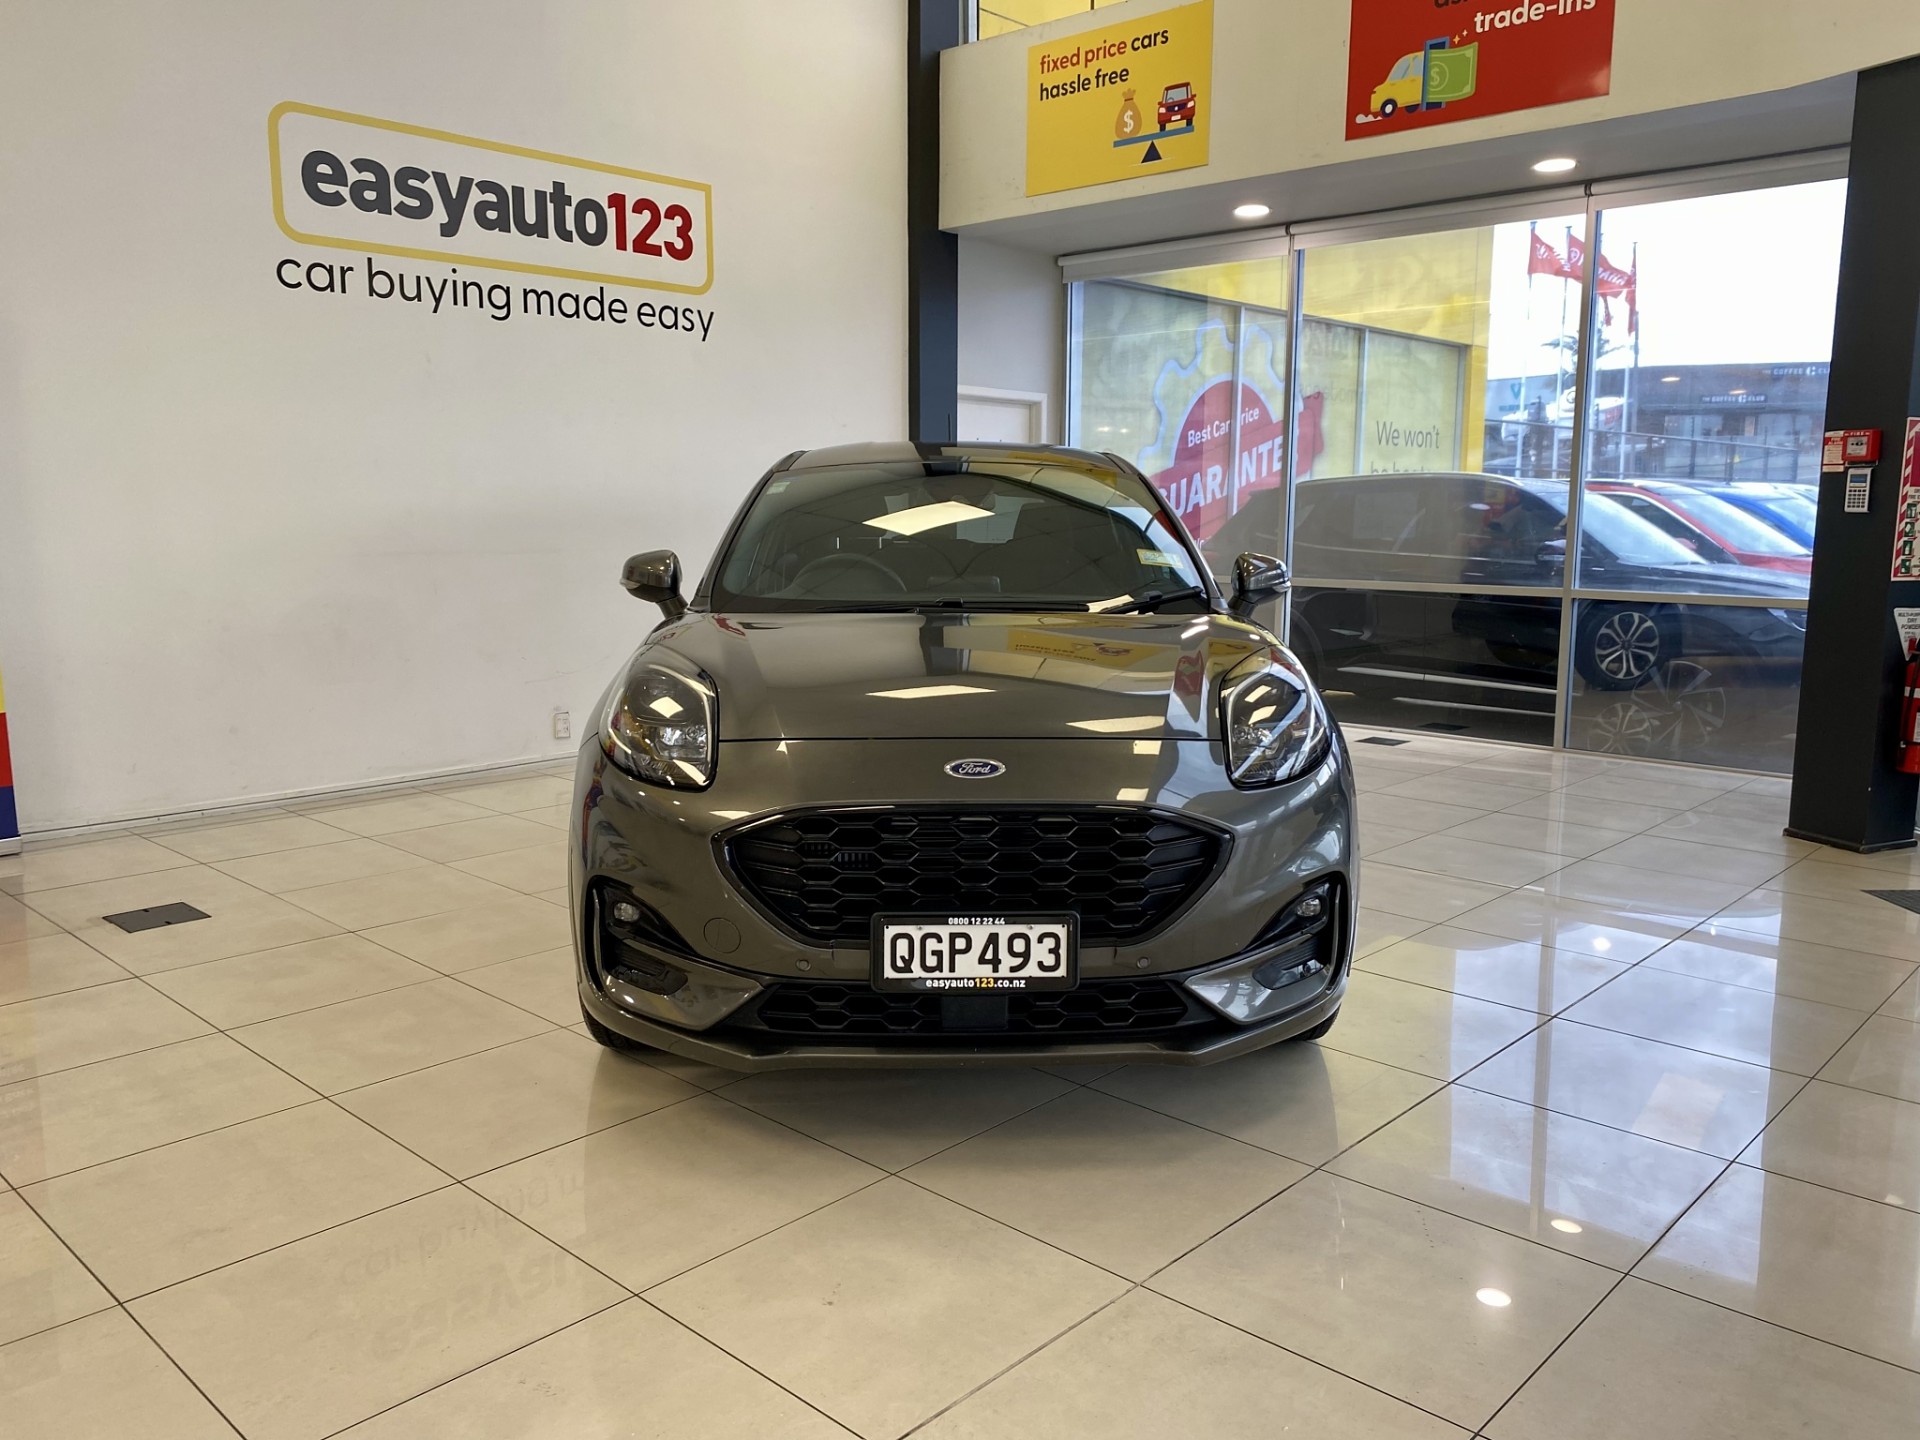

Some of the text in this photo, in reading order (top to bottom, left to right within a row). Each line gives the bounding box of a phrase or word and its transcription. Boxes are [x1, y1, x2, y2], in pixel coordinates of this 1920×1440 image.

[1040, 29, 1169, 75] fixed price cars
[1040, 68, 1130, 102] hassle free
[301, 149, 693, 262] easyauto123
[276, 256, 715, 342] car buying made easy
[1187, 407, 1260, 448] Best Car rice
[1376, 420, 1440, 449] We won't
[959, 762, 992, 775] Ford
[948, 917, 1006, 925] 0800 12 22 44
[890, 932, 1062, 974] QGP493
[926, 977, 1026, 990] easyauto123.co.nz
